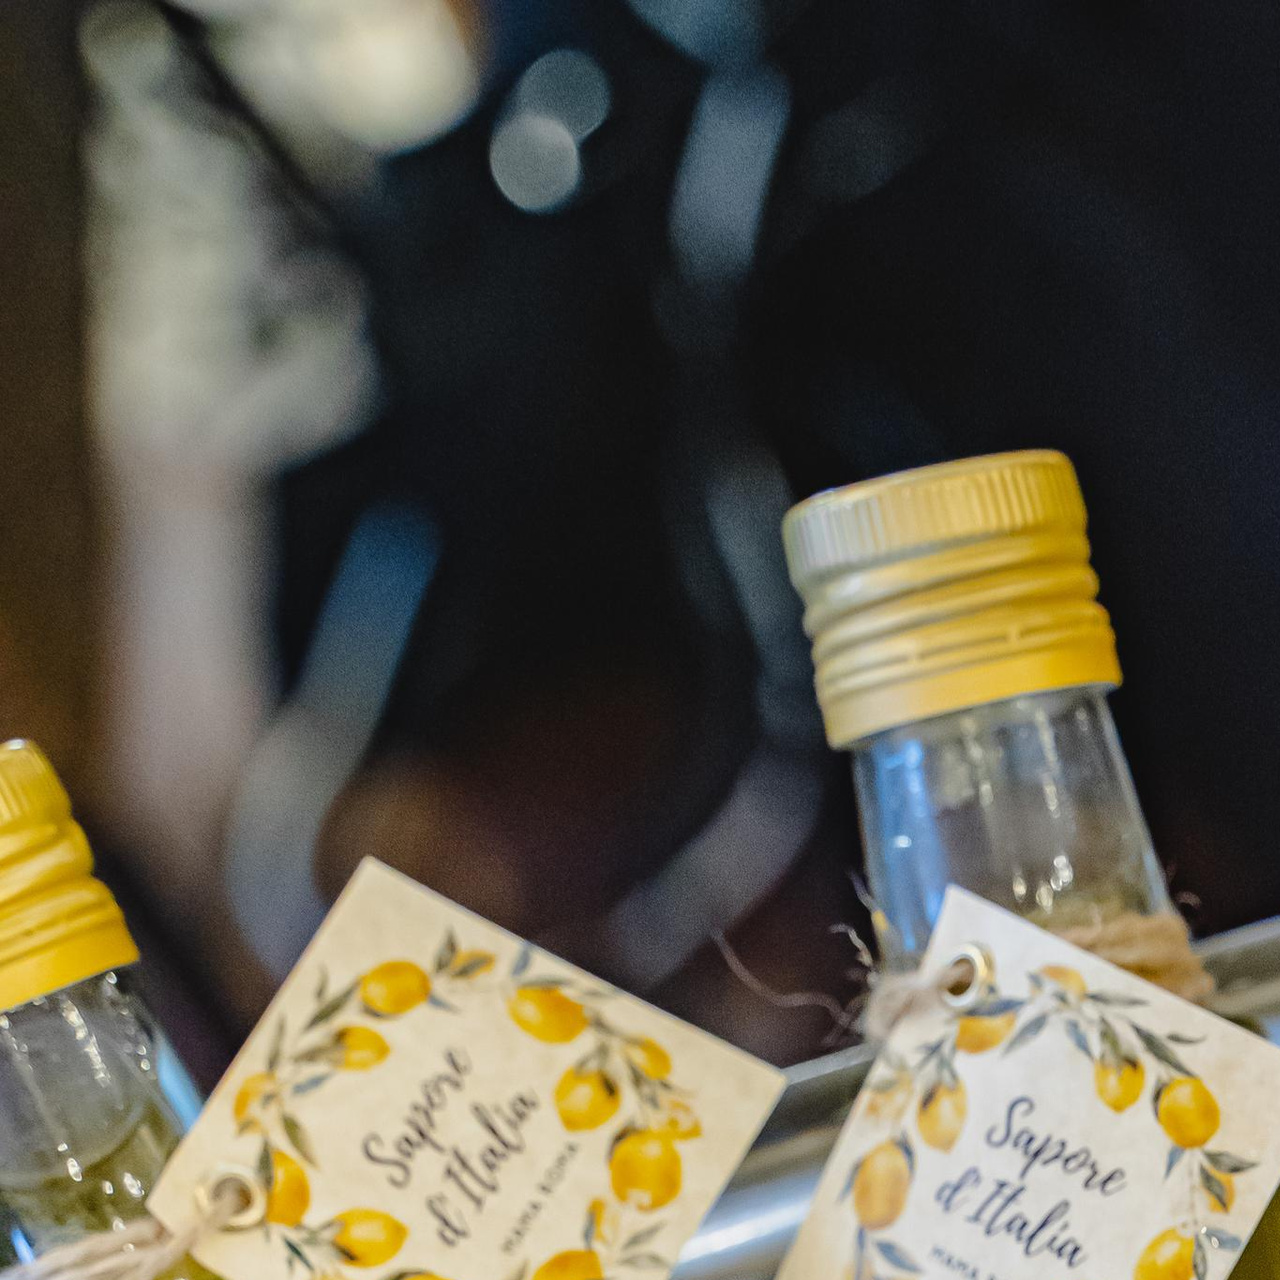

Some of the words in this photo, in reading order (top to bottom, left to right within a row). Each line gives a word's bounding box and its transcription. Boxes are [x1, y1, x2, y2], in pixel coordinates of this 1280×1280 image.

[363, 1048, 472, 1188] Sapore
[985, 1096, 1127, 1196] Sapore
[503, 1200, 542, 1252] MAMA
[539, 1142, 578, 1195] ROMA
[931, 1246, 980, 1280] MAMA
